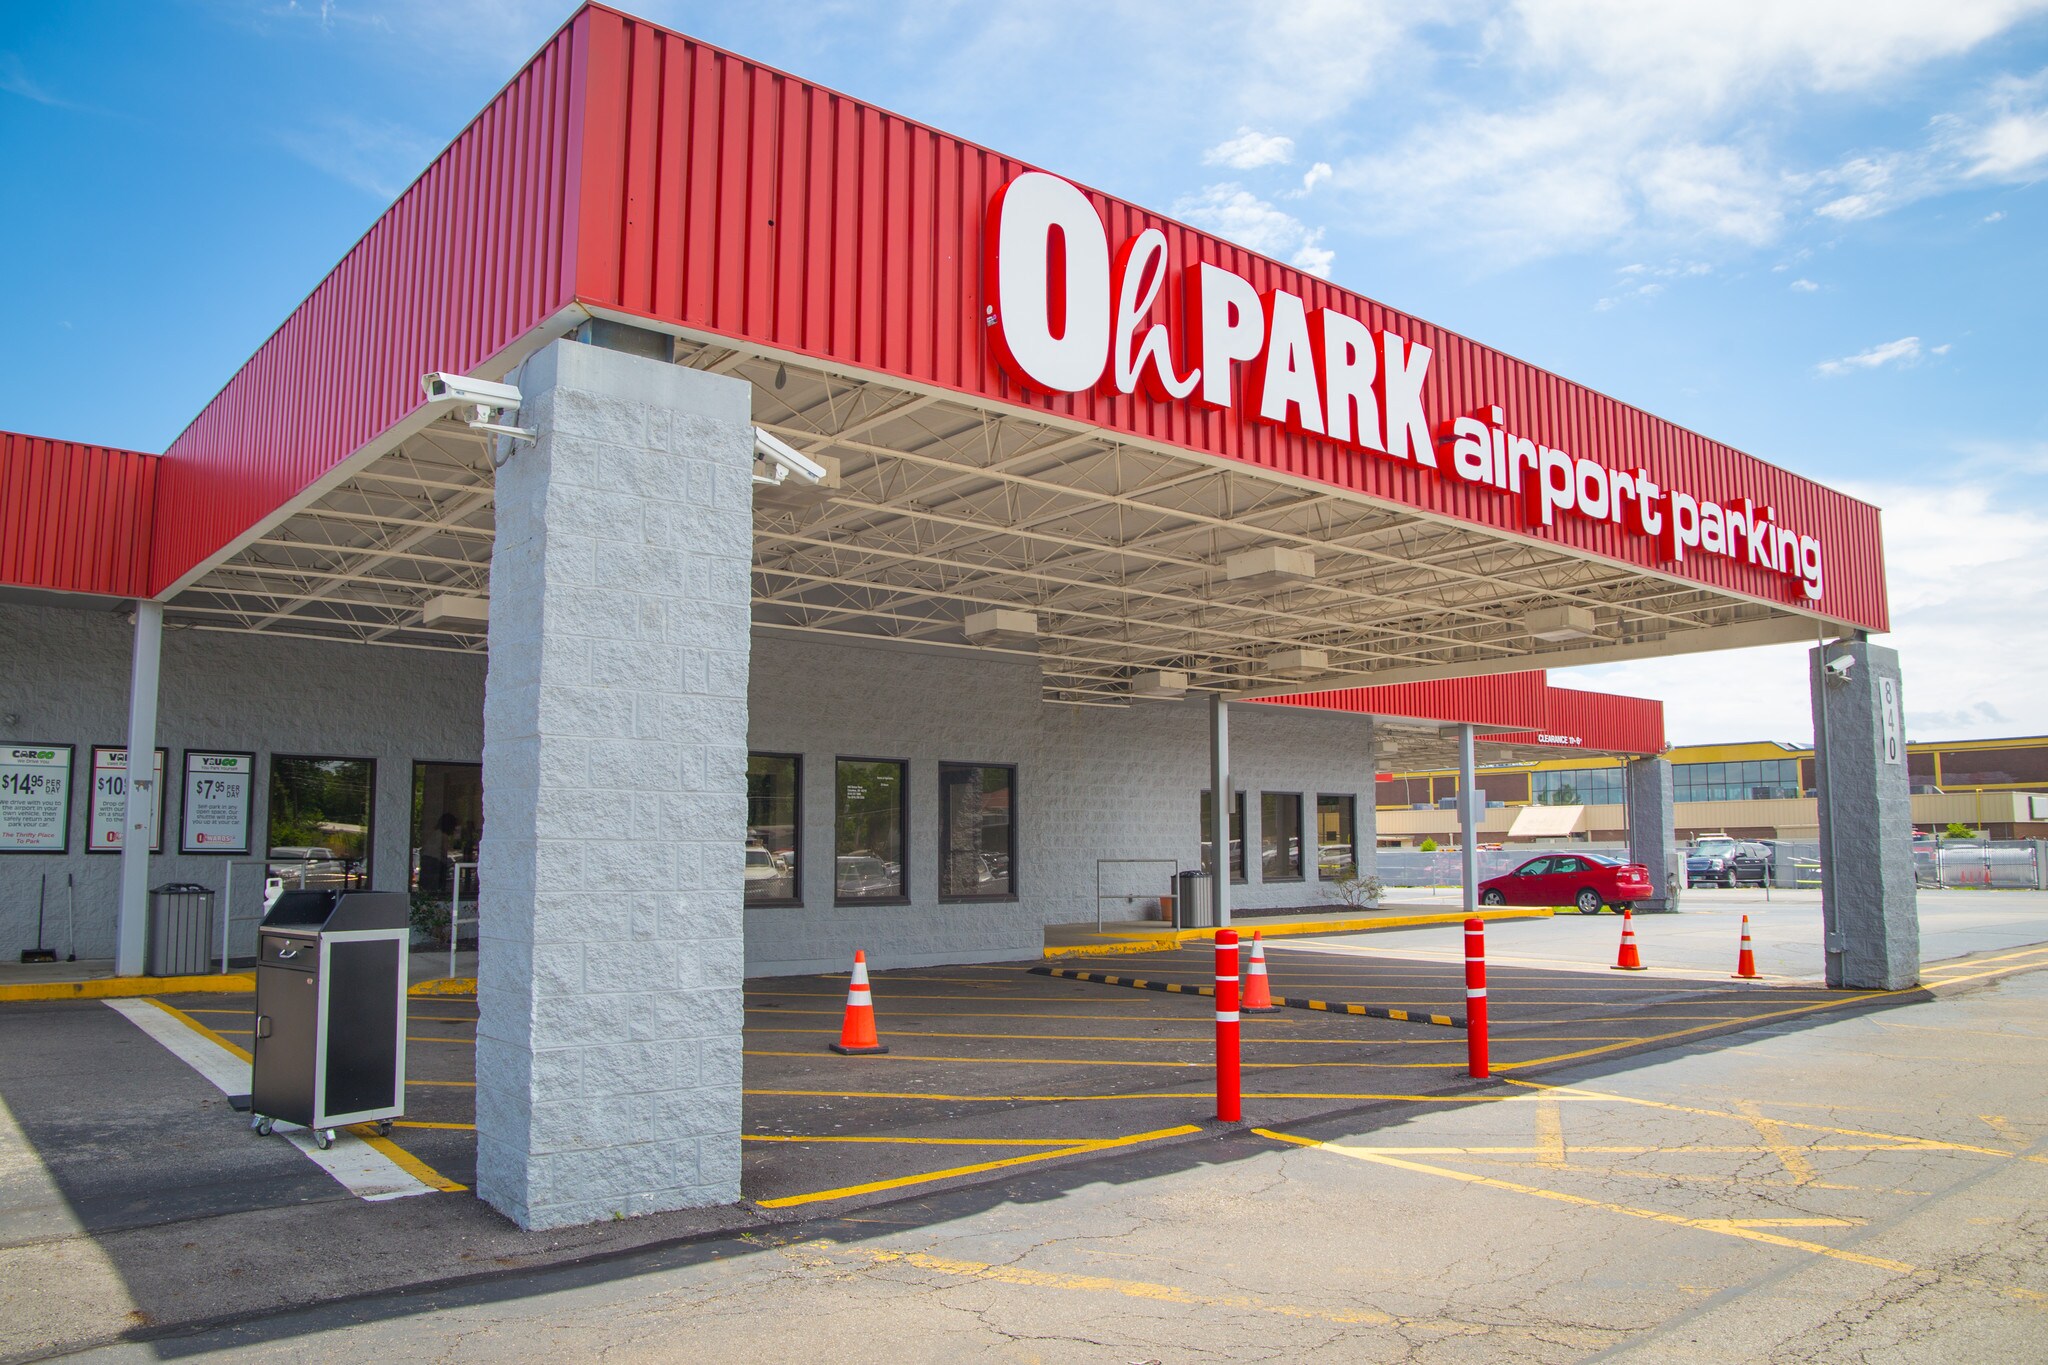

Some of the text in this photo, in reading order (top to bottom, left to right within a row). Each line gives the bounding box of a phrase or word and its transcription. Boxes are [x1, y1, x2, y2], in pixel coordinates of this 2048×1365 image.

[998, 171, 1823, 600] Oh PARK airport parking
[1885, 681, 1896, 760] 840
[1538, 734, 1568, 744] CLEARANCE
[12, 750, 56, 759] CARGO
[45, 786, 60, 794] DAY
[226, 784, 240, 792] PER
